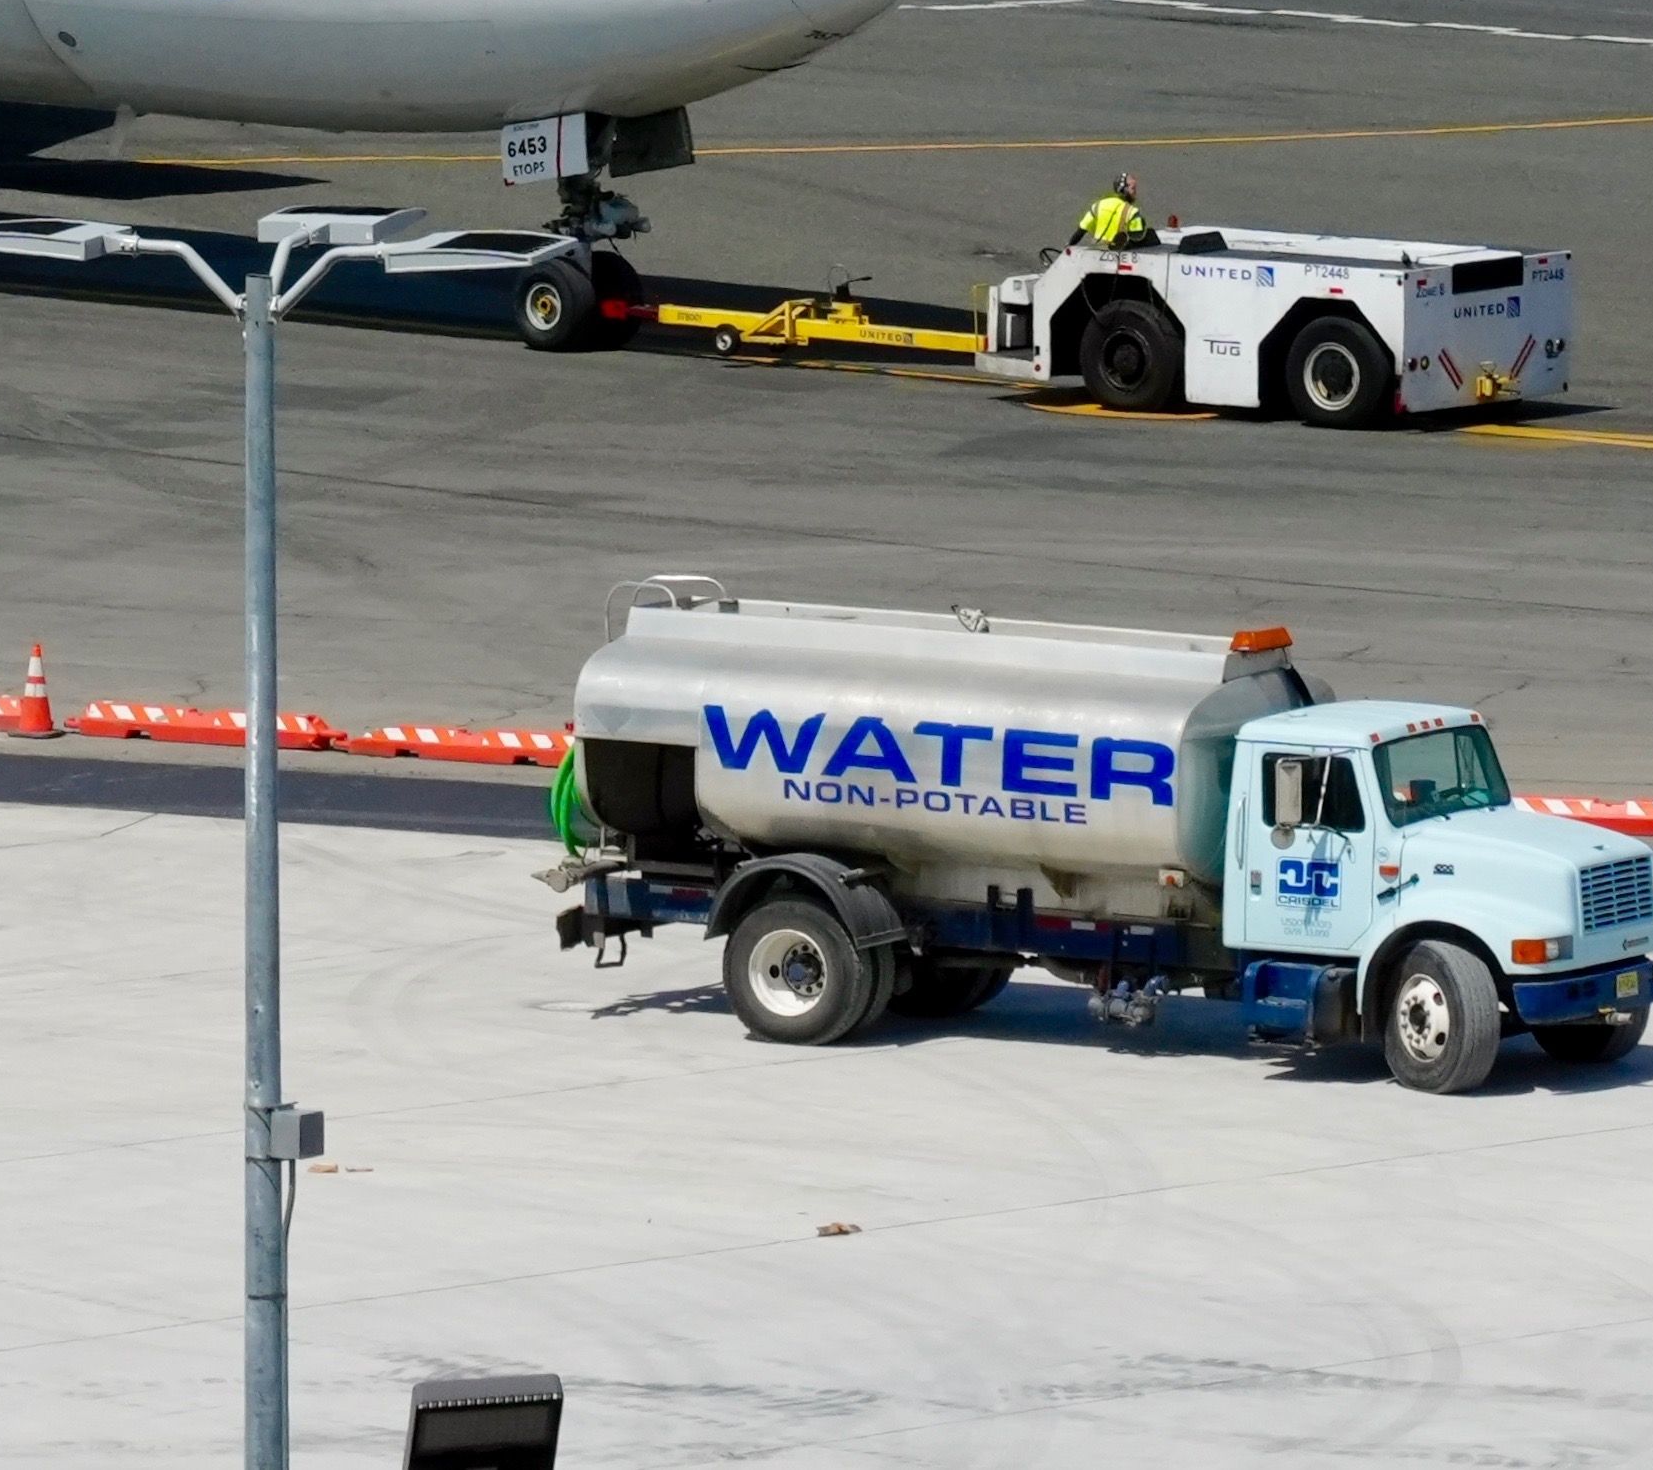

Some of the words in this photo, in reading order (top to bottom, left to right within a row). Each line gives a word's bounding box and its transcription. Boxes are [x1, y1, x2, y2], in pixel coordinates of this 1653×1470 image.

[508, 136, 548, 158] 6453
[513, 160, 545, 177] ETOPS
[1181, 265, 1252, 281] UNITED
[1304, 264, 1350, 279] PT2448
[1532, 268, 1564, 282] PT2448
[1454, 304, 1505, 318] UNITED
[860, 330, 902, 342] UNITED
[1202, 340, 1240, 357] TUG
[703, 704, 1174, 806] WATER
[783, 777, 1088, 826] NON-POTABLE
[1276, 895, 1339, 908] CRISDEL
